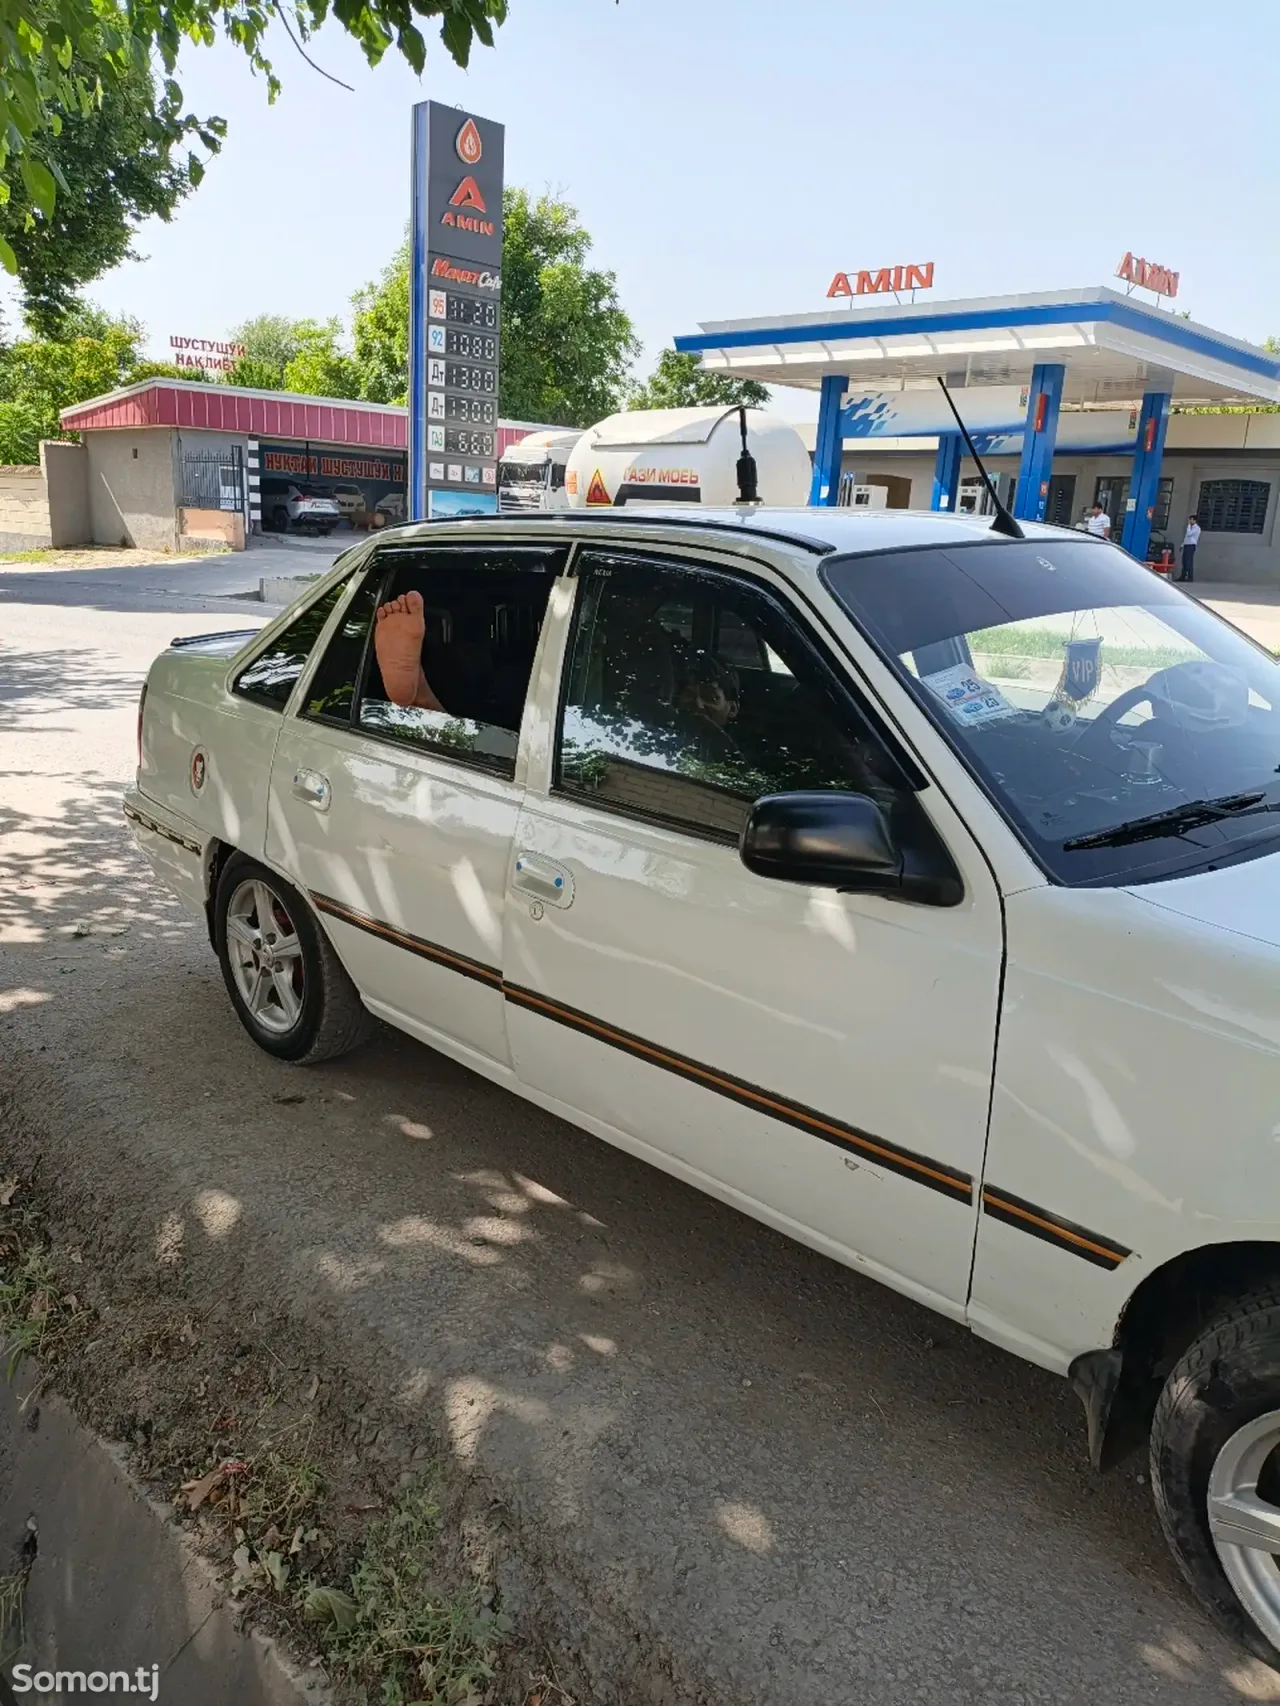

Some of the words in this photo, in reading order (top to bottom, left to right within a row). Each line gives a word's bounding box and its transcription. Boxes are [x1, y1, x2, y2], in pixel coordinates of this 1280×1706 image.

[441, 212, 493, 235] AMIN
[826, 262, 934, 298] AMIN
[432, 297, 444, 315] 95
[431, 330, 443, 347] 92
[623, 467, 656, 482] ГАЗИ
[1072, 659, 1094, 683] VIP
[960, 679, 981, 693] 25
